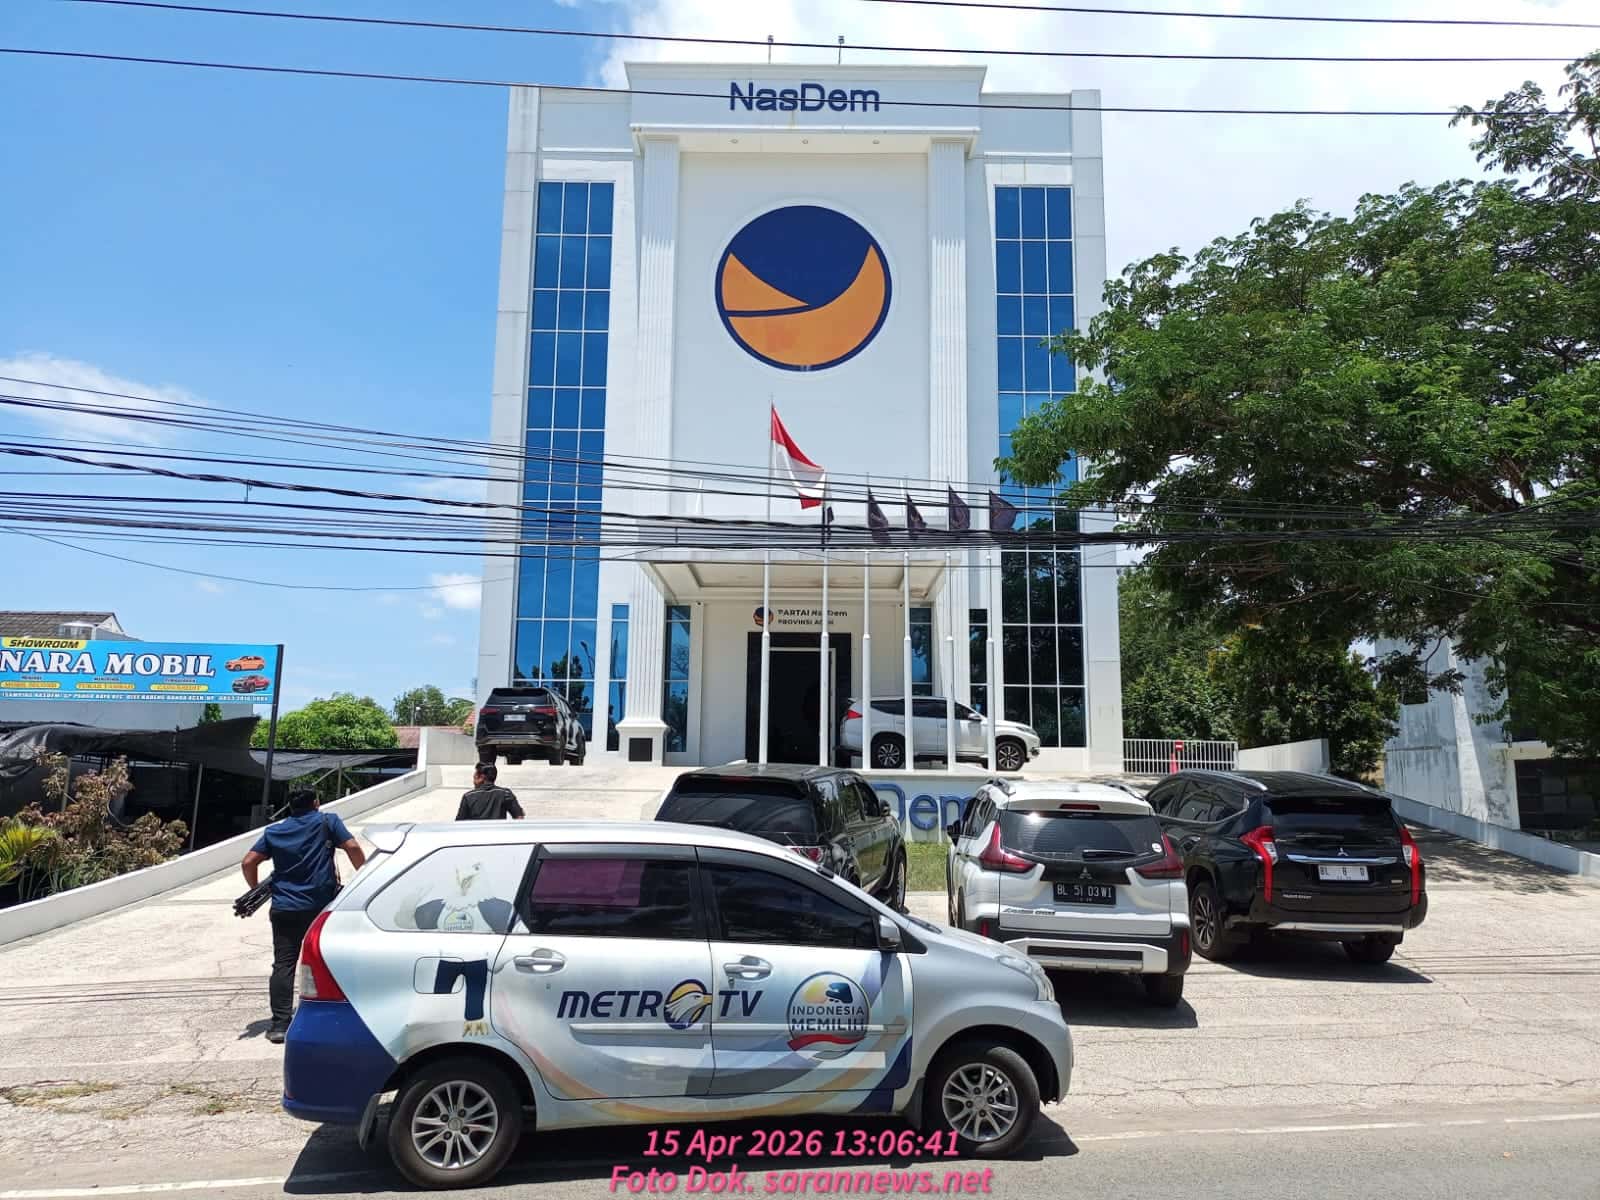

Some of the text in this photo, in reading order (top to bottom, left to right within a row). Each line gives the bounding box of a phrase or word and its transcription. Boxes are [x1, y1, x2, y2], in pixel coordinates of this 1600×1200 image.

[729, 81, 880, 113] NasDem
[777, 609, 809, 617] PARTAI
[9, 639, 79, 649] SHOWROOM
[0, 650, 216, 678] NARA MOBIL
[1057, 883, 1068, 896] BL
[719, 990, 763, 1017] TV
[791, 1005, 865, 1017] INDONESIA
[791, 1018, 865, 1032] MEMILIH
